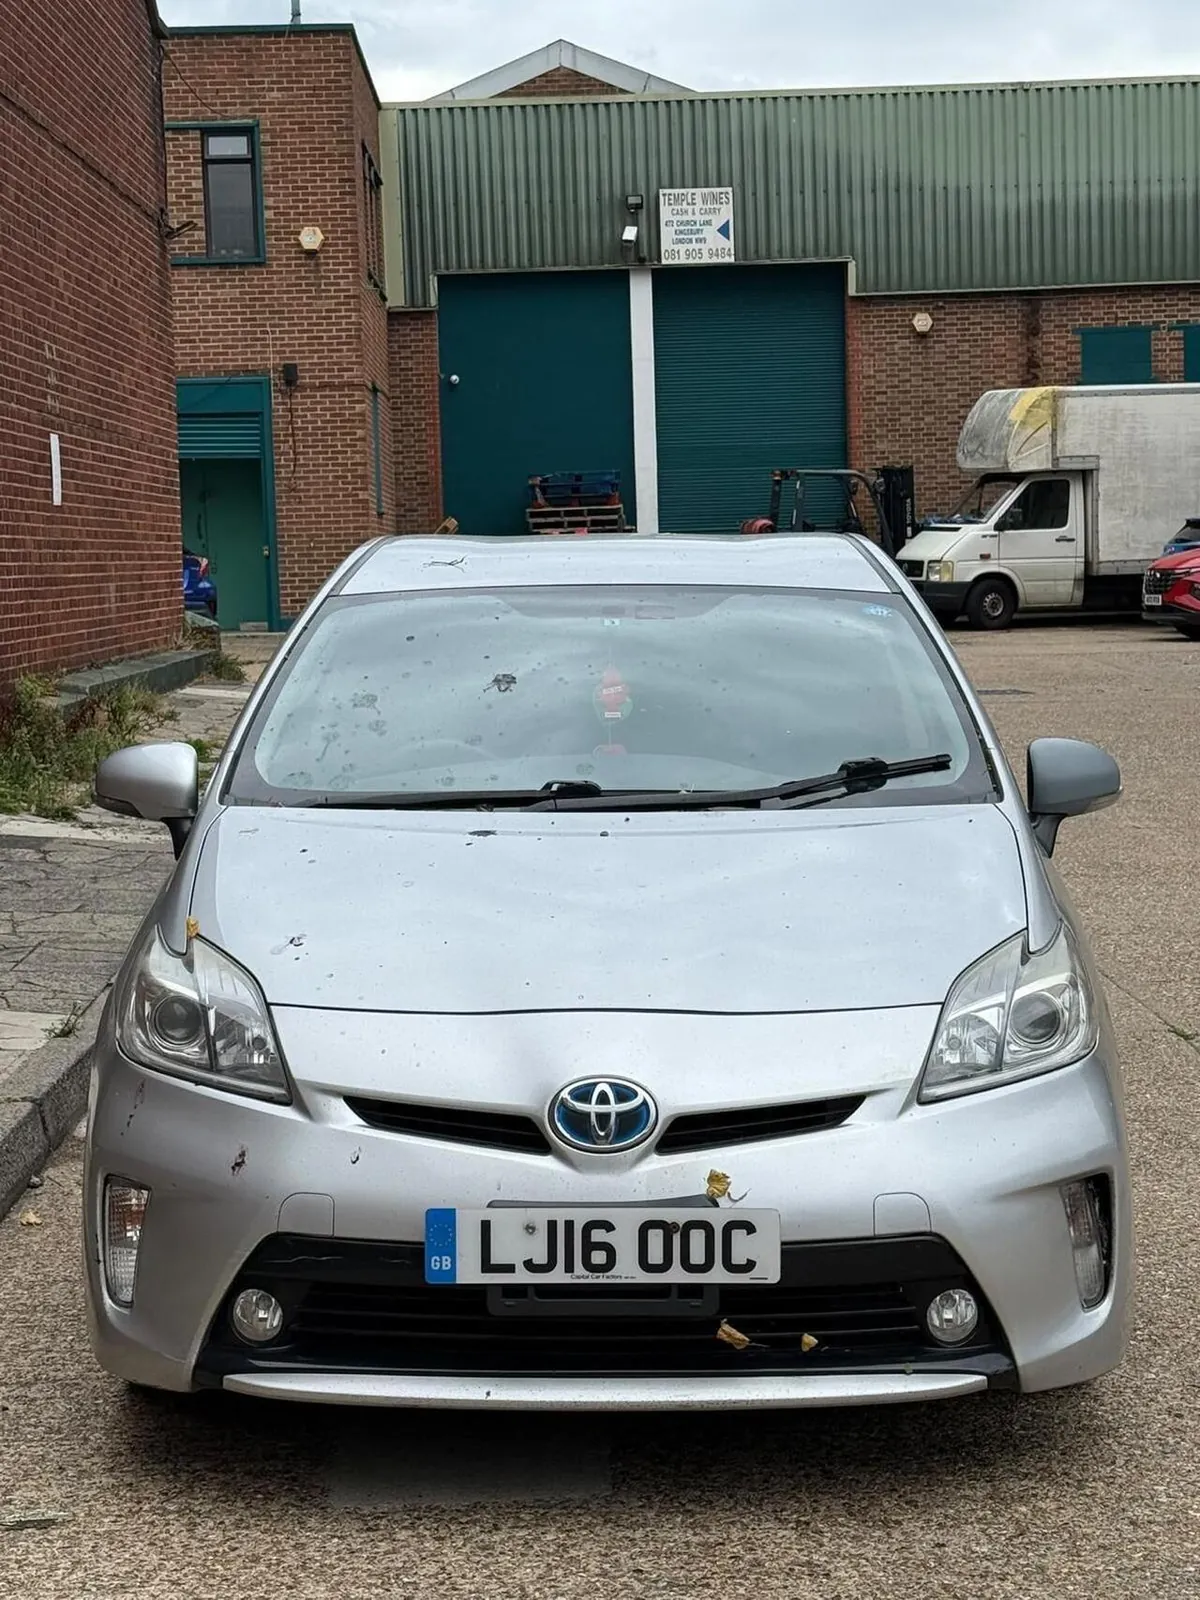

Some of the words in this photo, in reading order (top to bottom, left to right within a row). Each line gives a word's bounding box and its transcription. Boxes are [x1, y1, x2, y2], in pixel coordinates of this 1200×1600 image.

[662, 192, 697, 206] TEMPLE
[701, 191, 731, 206] WINES
[671, 207, 689, 216] CASH
[691, 207, 696, 216] &
[699, 207, 722, 216] CARRY
[664, 219, 675, 227] 472
[676, 219, 698, 227] CHURCH
[699, 219, 713, 227] LANE
[674, 228, 704, 236] KINGSBURY
[672, 237, 694, 245] LONDON
[663, 249, 681, 261] 081
[684, 248, 704, 260] 905
[707, 247, 733, 260] 9484
[480, 1219, 617, 1275] LJ16
[431, 1255, 452, 1271] GB
